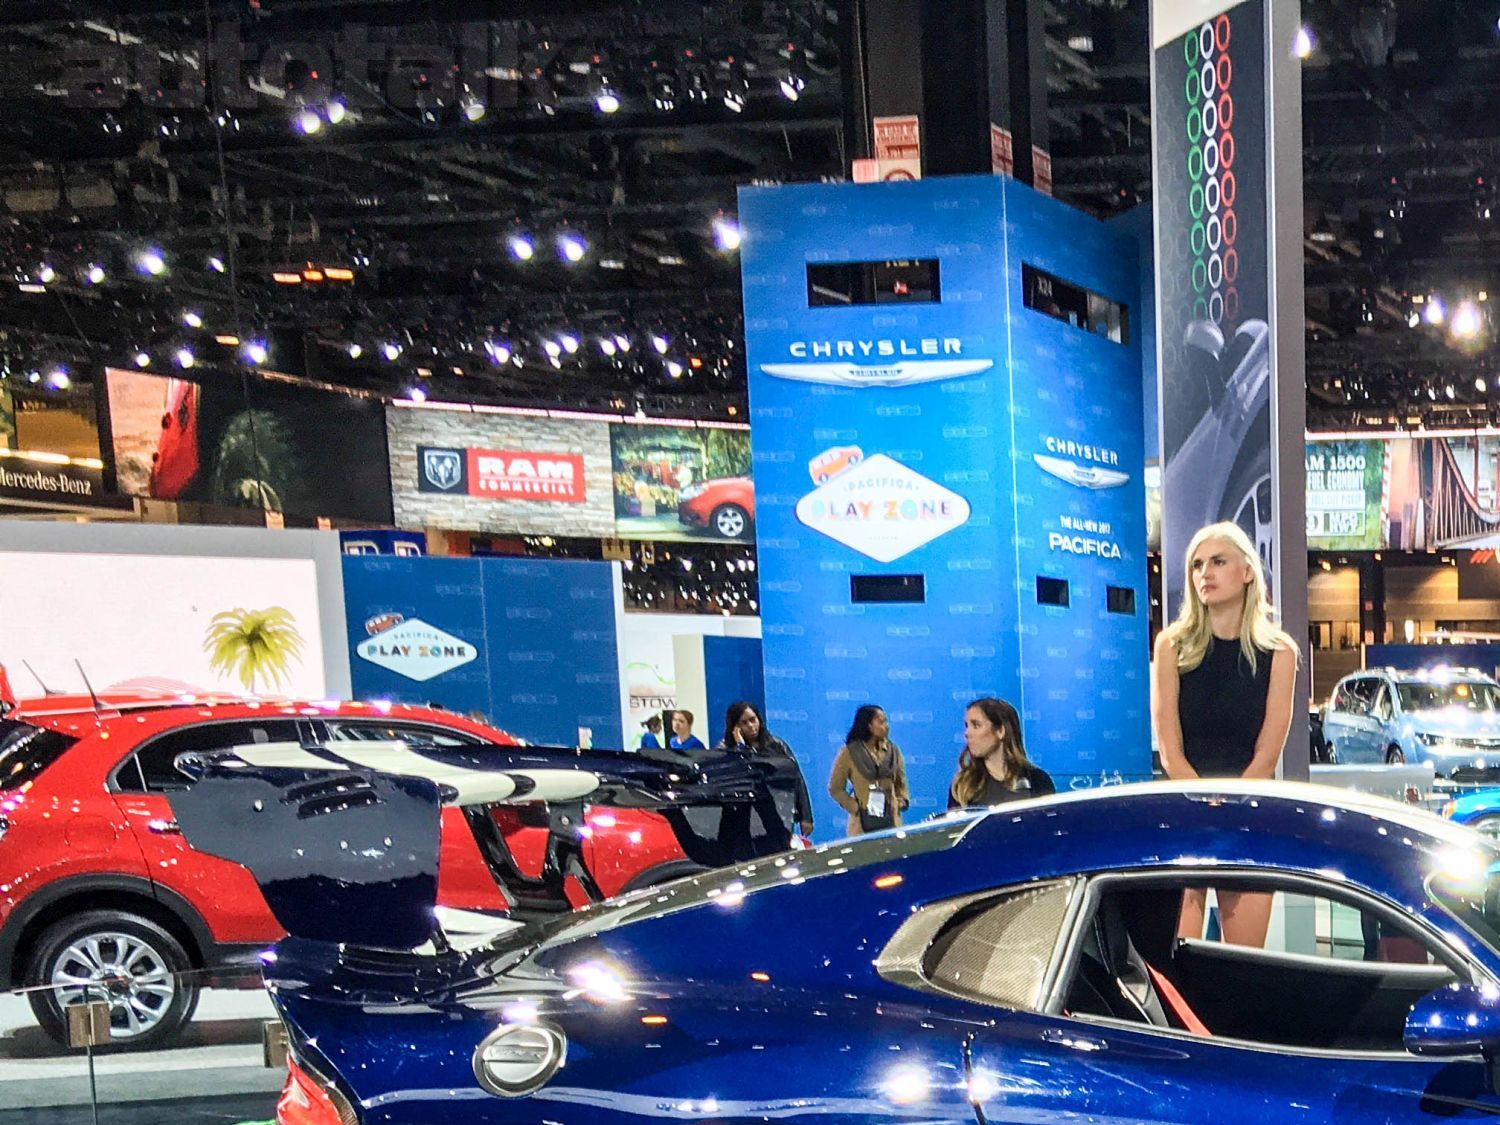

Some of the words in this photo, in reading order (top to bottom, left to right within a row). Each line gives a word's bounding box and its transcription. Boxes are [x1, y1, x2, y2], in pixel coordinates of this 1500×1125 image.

[789, 337, 962, 357] CHRYSLER
[1046, 436, 1119, 466] CHRYSLER
[477, 455, 575, 480] RAM
[1330, 454, 1367, 470] 1500
[479, 480, 577, 496] COMMERCIAL
[884, 500, 953, 520] ZONE
[1048, 531, 1122, 559] PACIFICA
[367, 645, 410, 657] PLAY
[419, 645, 465, 657] ZONE
[629, 697, 677, 709] STOW
